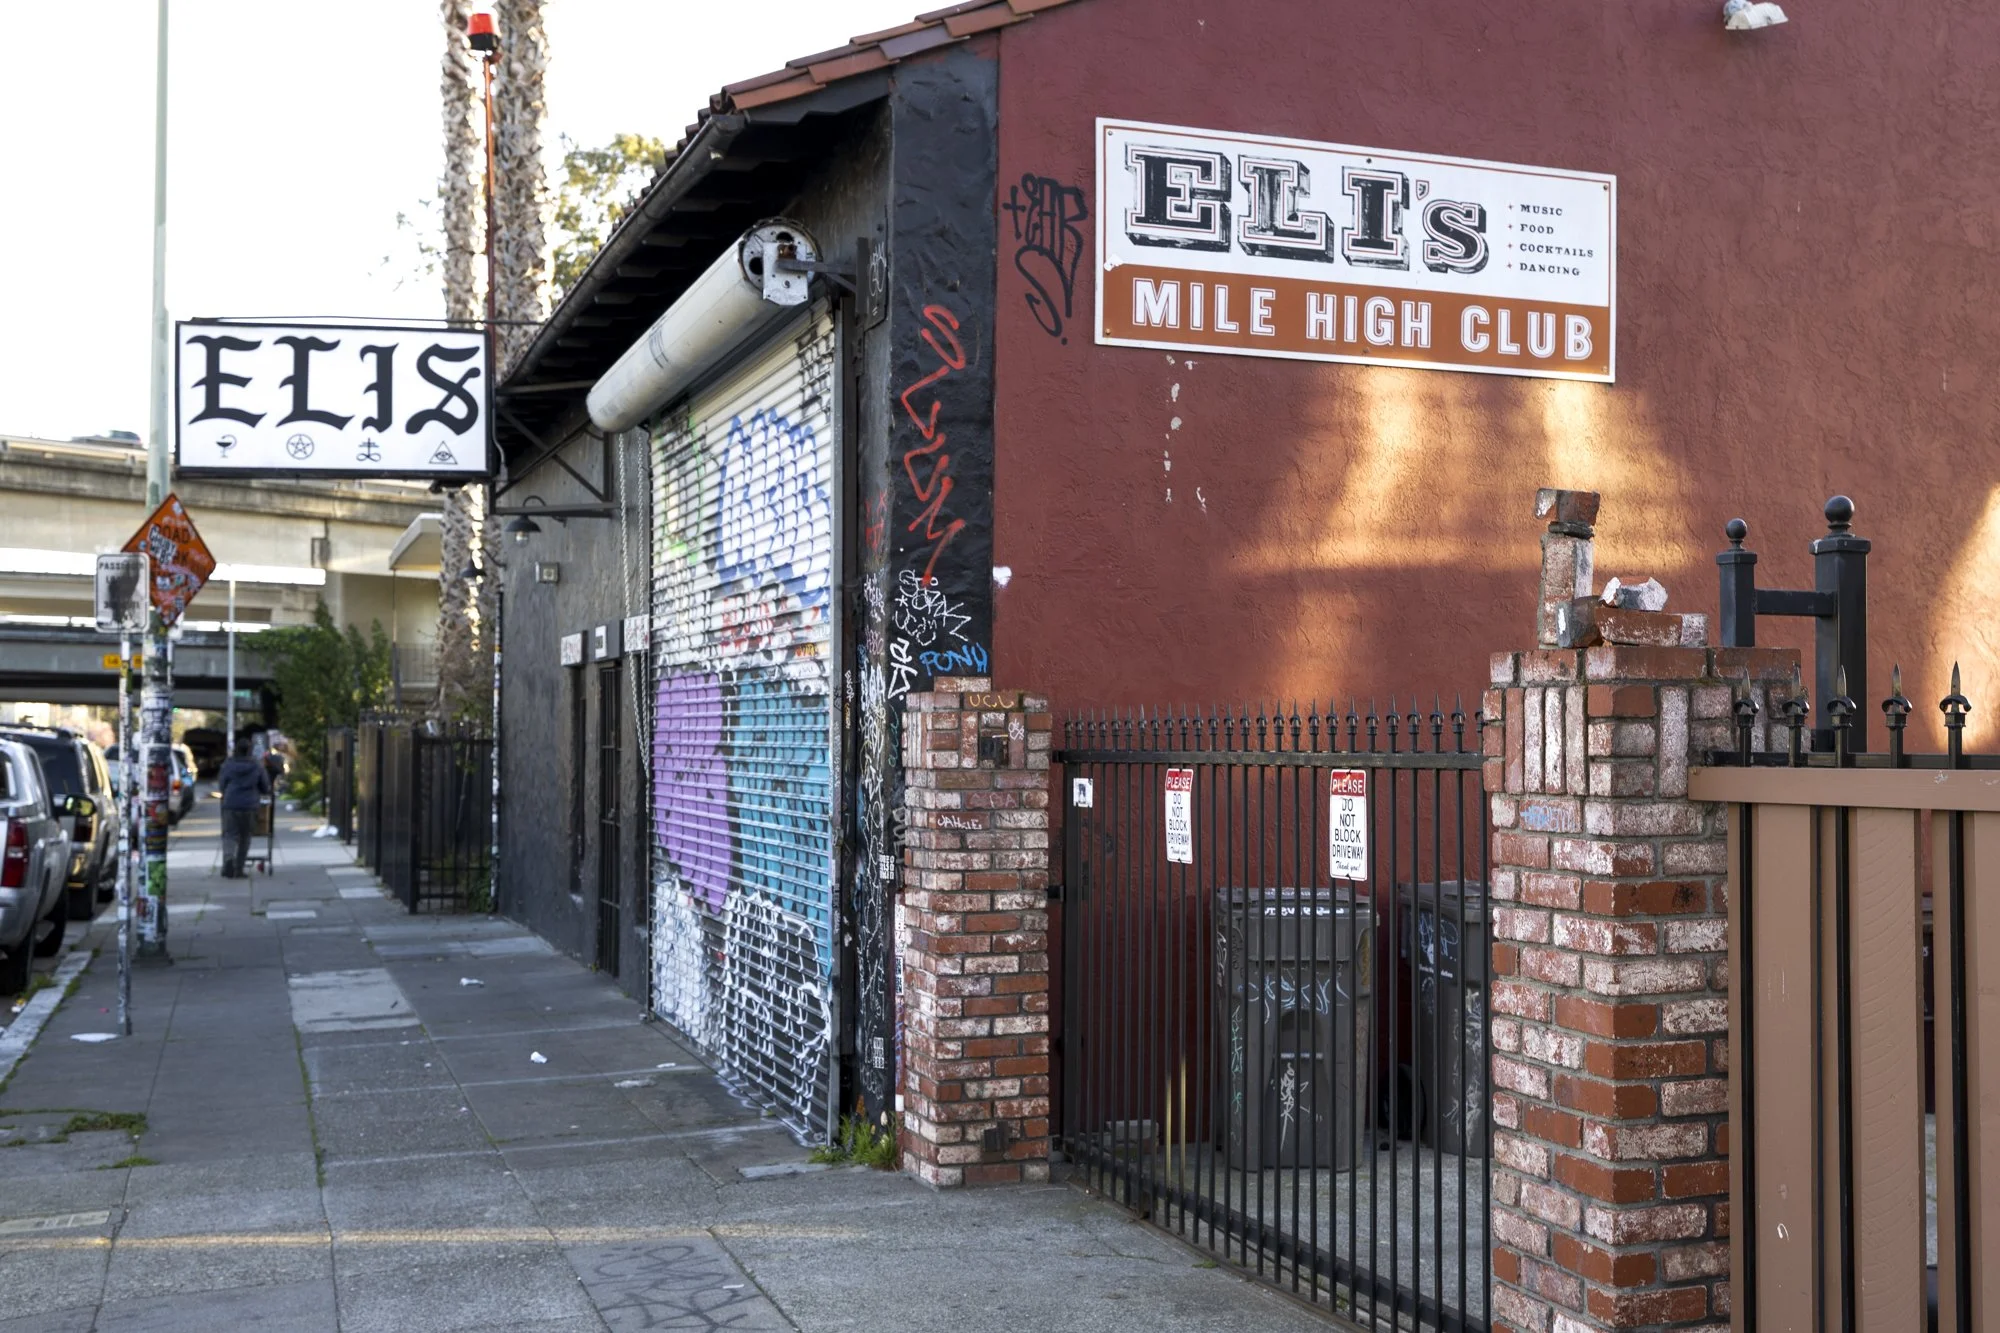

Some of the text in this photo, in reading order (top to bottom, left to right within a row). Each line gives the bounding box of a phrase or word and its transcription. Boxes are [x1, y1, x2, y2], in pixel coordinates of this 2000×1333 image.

[1124, 142, 1489, 274] ELI'S
[1520, 203, 1563, 216] MUSIC
[1520, 223, 1554, 235] FOOD
[1519, 242, 1594, 258] COCKTAILS
[1519, 262, 1580, 276] DANCING
[1132, 277, 1593, 360] MILE HIGH CLUB
[186, 334, 481, 436] ELIS
[1166, 776, 1191, 790] PLEASE
[1332, 778, 1363, 793] PLEASE
[1173, 793, 1182, 805] DO
[1342, 798, 1353, 811] DO
[1171, 806, 1183, 818] NOT
[1168, 818, 1188, 831] BLOCK
[1340, 814, 1356, 828] NOT
[1168, 832, 1190, 845] DRIVEWAY
[1334, 828, 1361, 843] BLOCK
[1332, 844, 1364, 860] DRIVEWAY
[1335, 861, 1349, 870] Thank
